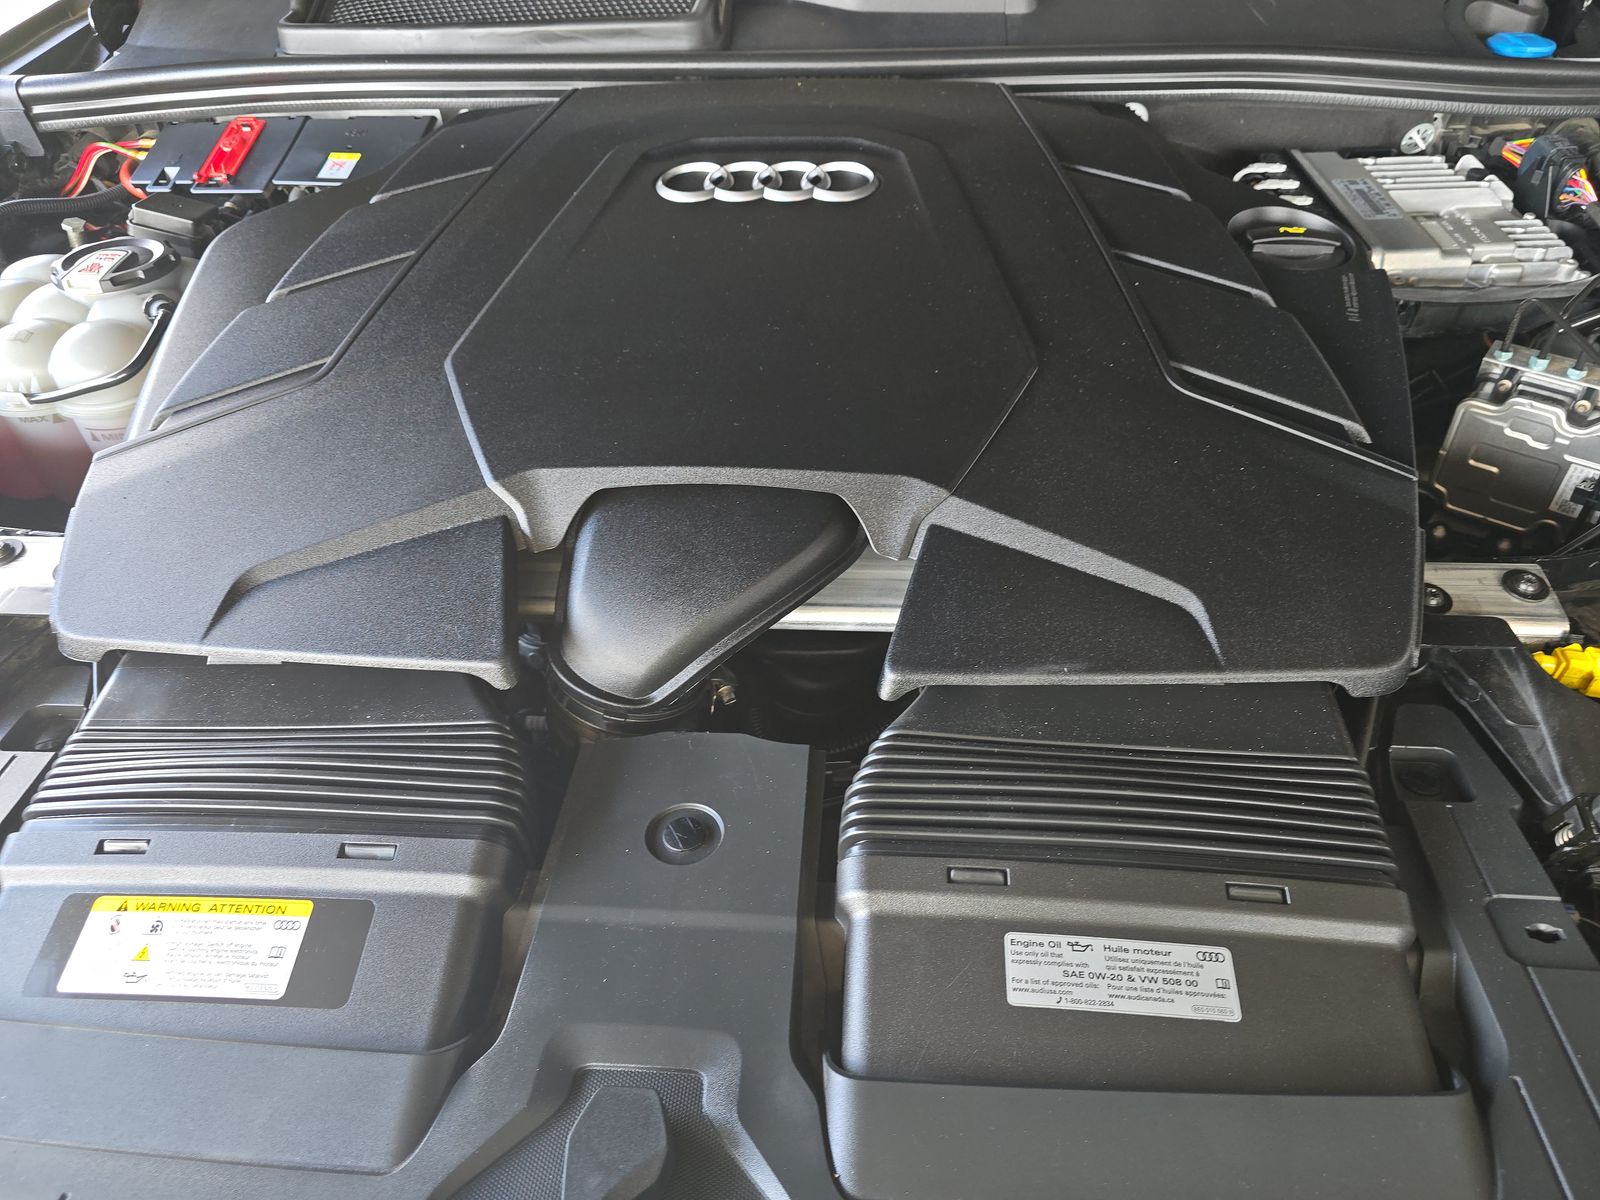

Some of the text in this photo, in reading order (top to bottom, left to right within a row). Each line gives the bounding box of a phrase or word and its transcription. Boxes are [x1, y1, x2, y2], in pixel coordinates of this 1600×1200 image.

[18, 415, 48, 423] MAX
[135, 903, 288, 914] WARNING ATTENTION
[1010, 939, 1044, 948] Engine
[1103, 945, 1172, 956] Huile moteur
[1011, 959, 1042, 967] expressly
[1062, 970, 1085, 979] SAE
[1088, 972, 1124, 981] 0W-20
[1162, 978, 1182, 986] 508
[1185, 979, 1198, 987] 00
[1051, 980, 1083, 988] approved
[1012, 987, 1073, 995] www.audiusa.com
[1065, 997, 1115, 1007] 1-800-822-2834
[1108, 993, 1175, 1003] www.audicanada.ca
